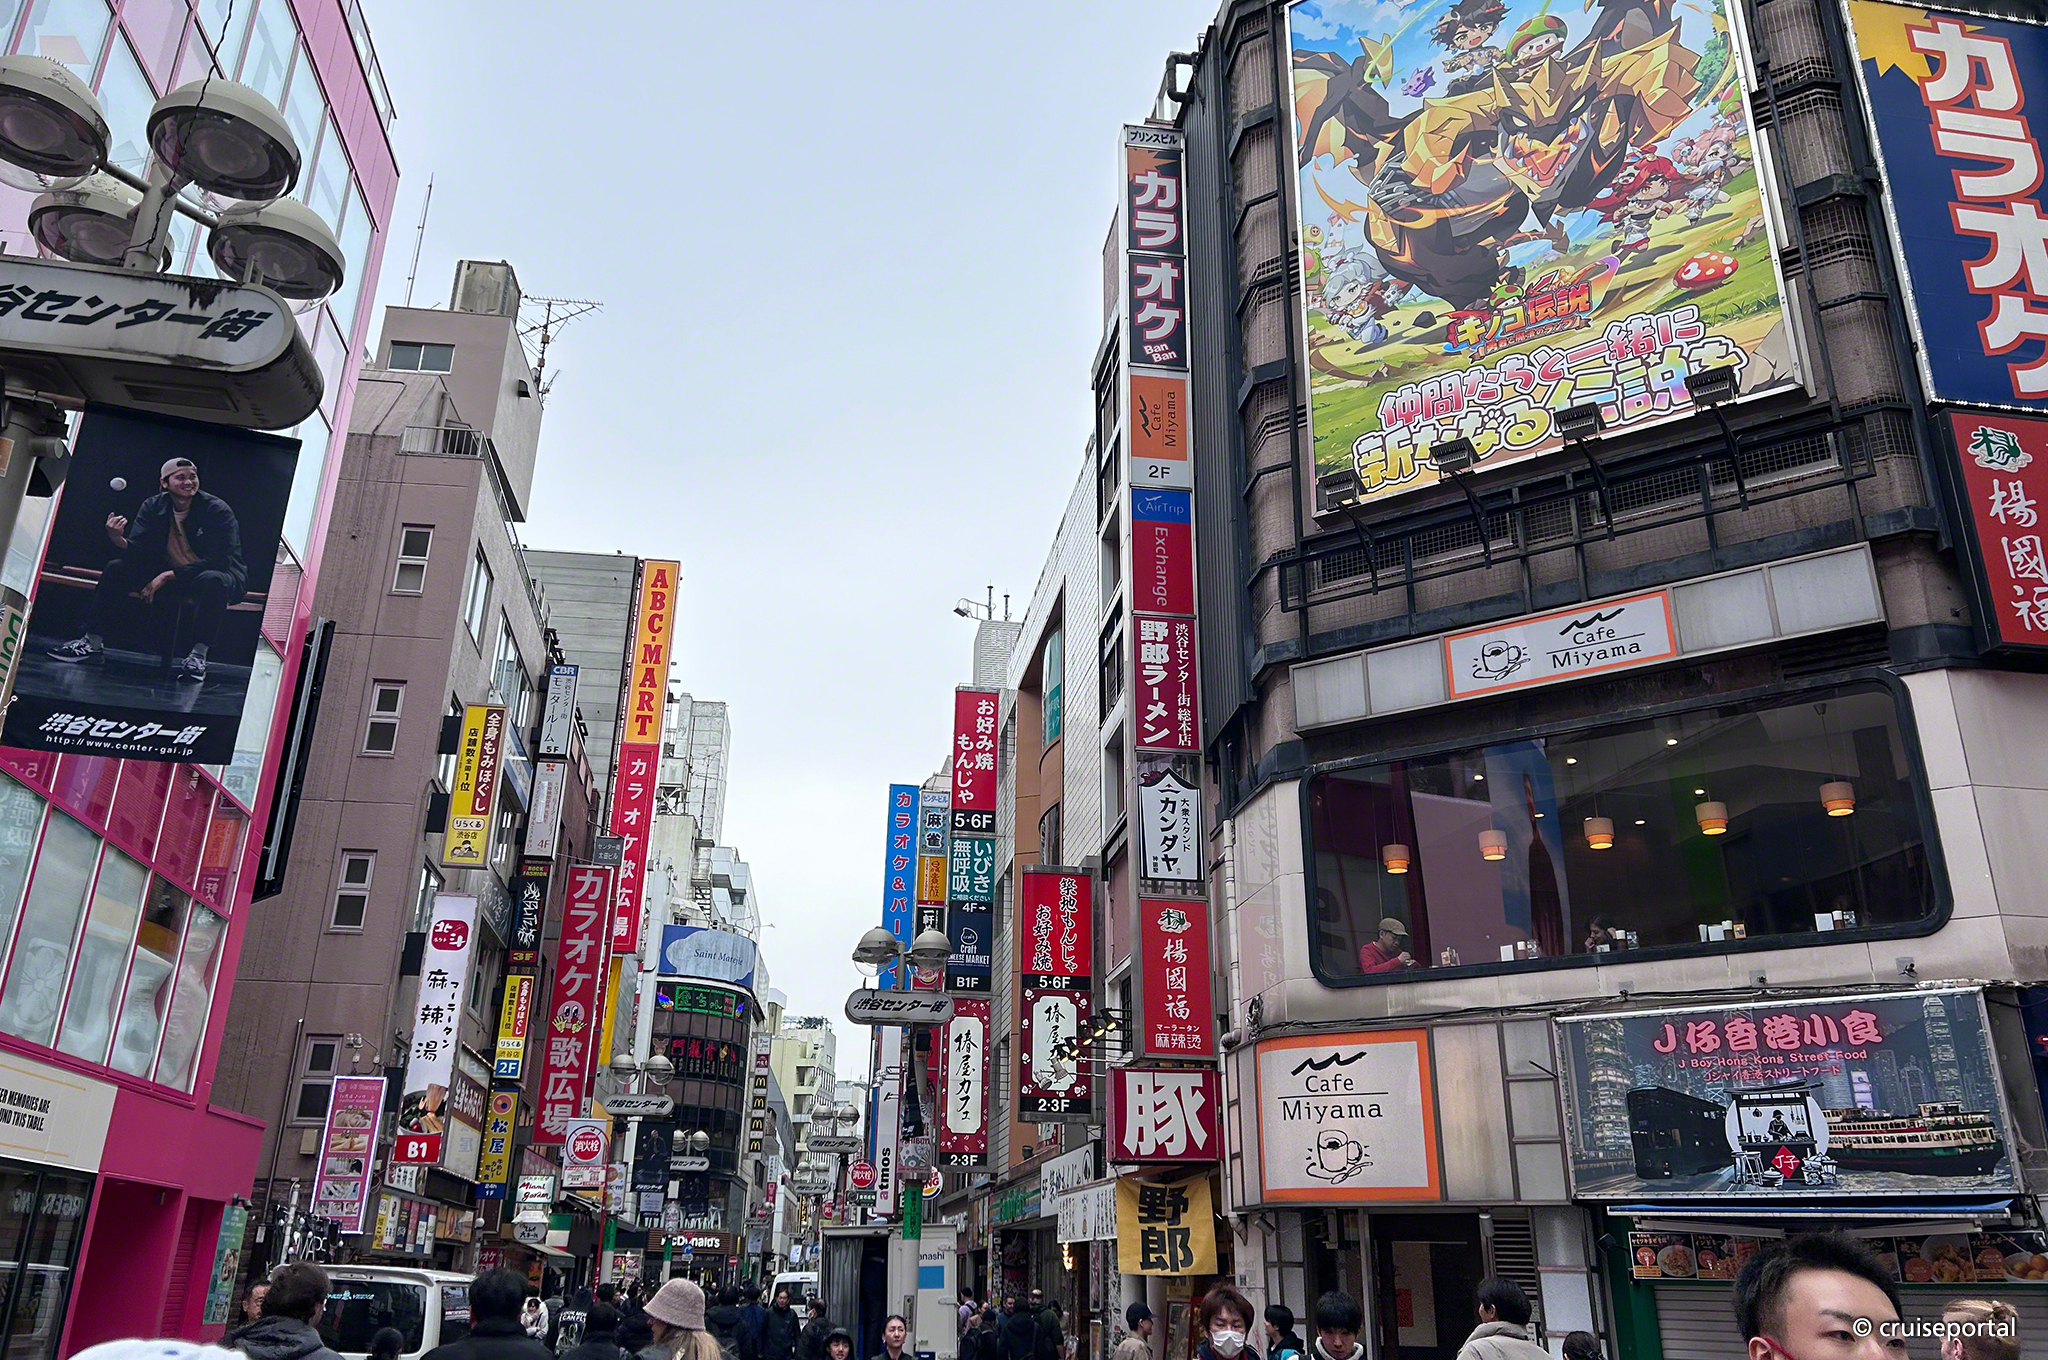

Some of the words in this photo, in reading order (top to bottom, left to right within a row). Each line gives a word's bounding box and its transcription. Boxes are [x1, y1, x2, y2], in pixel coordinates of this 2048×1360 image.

[1130, 130, 1178, 145] プリンスビル
[1908, 18, 2048, 397] カラオケ
[1133, 169, 1181, 341] カラオケ
[1456, 282, 1592, 346] キノコ伝説
[1144, 342, 1169, 355] Ban
[1152, 350, 1178, 363] Ban
[1379, 307, 1704, 428] 仲間たちと一緒に
[1151, 403, 1162, 431] Cafe
[1165, 391, 1178, 447] Miyama
[1148, 464, 1171, 479] 2F
[1145, 501, 1184, 516] AirTrip
[1154, 526, 1169, 607] Exchange
[1572, 626, 1616, 646] Cafe
[1551, 641, 1643, 669] Miyama
[552, 666, 576, 675] CBR
[1140, 619, 1171, 745] 野郎ラーメン
[544, 677, 563, 743] モニタールーム
[38, 712, 208, 745] 渋谷センター街
[974, 699, 995, 771] お好み焼
[45, 734, 194, 757] http://www.center-gai.jp
[475, 712, 502, 812] 全身もみほぐし
[955, 733, 975, 804] もんじゃ
[455, 820, 482, 829] りらくる
[926, 812, 944, 849] 麻雀
[1159, 796, 1179, 873] カンダヤ
[951, 839, 972, 894] 無呼吸
[972, 841, 993, 894] いびき
[961, 902, 978, 913] 4F
[559, 869, 603, 998] カラオケ
[1032, 903, 1054, 972] お好み焼
[1059, 877, 1078, 974] 築地もんじゃ
[512, 952, 535, 961] 3F
[694, 949, 717, 960] Saint
[960, 944, 978, 954] Craft
[965, 954, 990, 965] MARKET
[956, 976, 979, 988] B1F
[1162, 938, 1191, 1020] 楊國福
[415, 968, 450, 1062] 麻辣湯
[514, 980, 531, 1036] 全身もみほぐし
[853, 998, 948, 1013] 渋谷センター街
[1155, 1023, 1200, 1033] マーラータン
[1652, 1009, 1884, 1055] J仔香港小食
[500, 1040, 522, 1048] りらくる
[498, 1061, 516, 1074] 2F
[1678, 1060, 1685, 1069] J
[1691, 1058, 1713, 1069] Boy
[1717, 1055, 1749, 1067] Hong
[1753, 1052, 1785, 1065] Kong
[1789, 1050, 1830, 1063] Street
[1834, 1049, 1868, 1060] Food
[953, 1029, 979, 1121] 椿屋カフェ
[1305, 1073, 1355, 1093] Cafe
[12, 1113, 26, 1127] THIS
[38, 1100, 51, 1114] ARE
[1123, 1071, 1208, 1157] 豚
[1282, 1099, 1384, 1125] Miyama
[406, 1141, 427, 1159] B1
[488, 1117, 510, 1155] 松屋
[574, 1140, 600, 1152] 消火栓
[879, 1147, 891, 1201] atmos
[661, 1235, 721, 1248] cDnald's
[1137, 1184, 1194, 1273] 野郎
